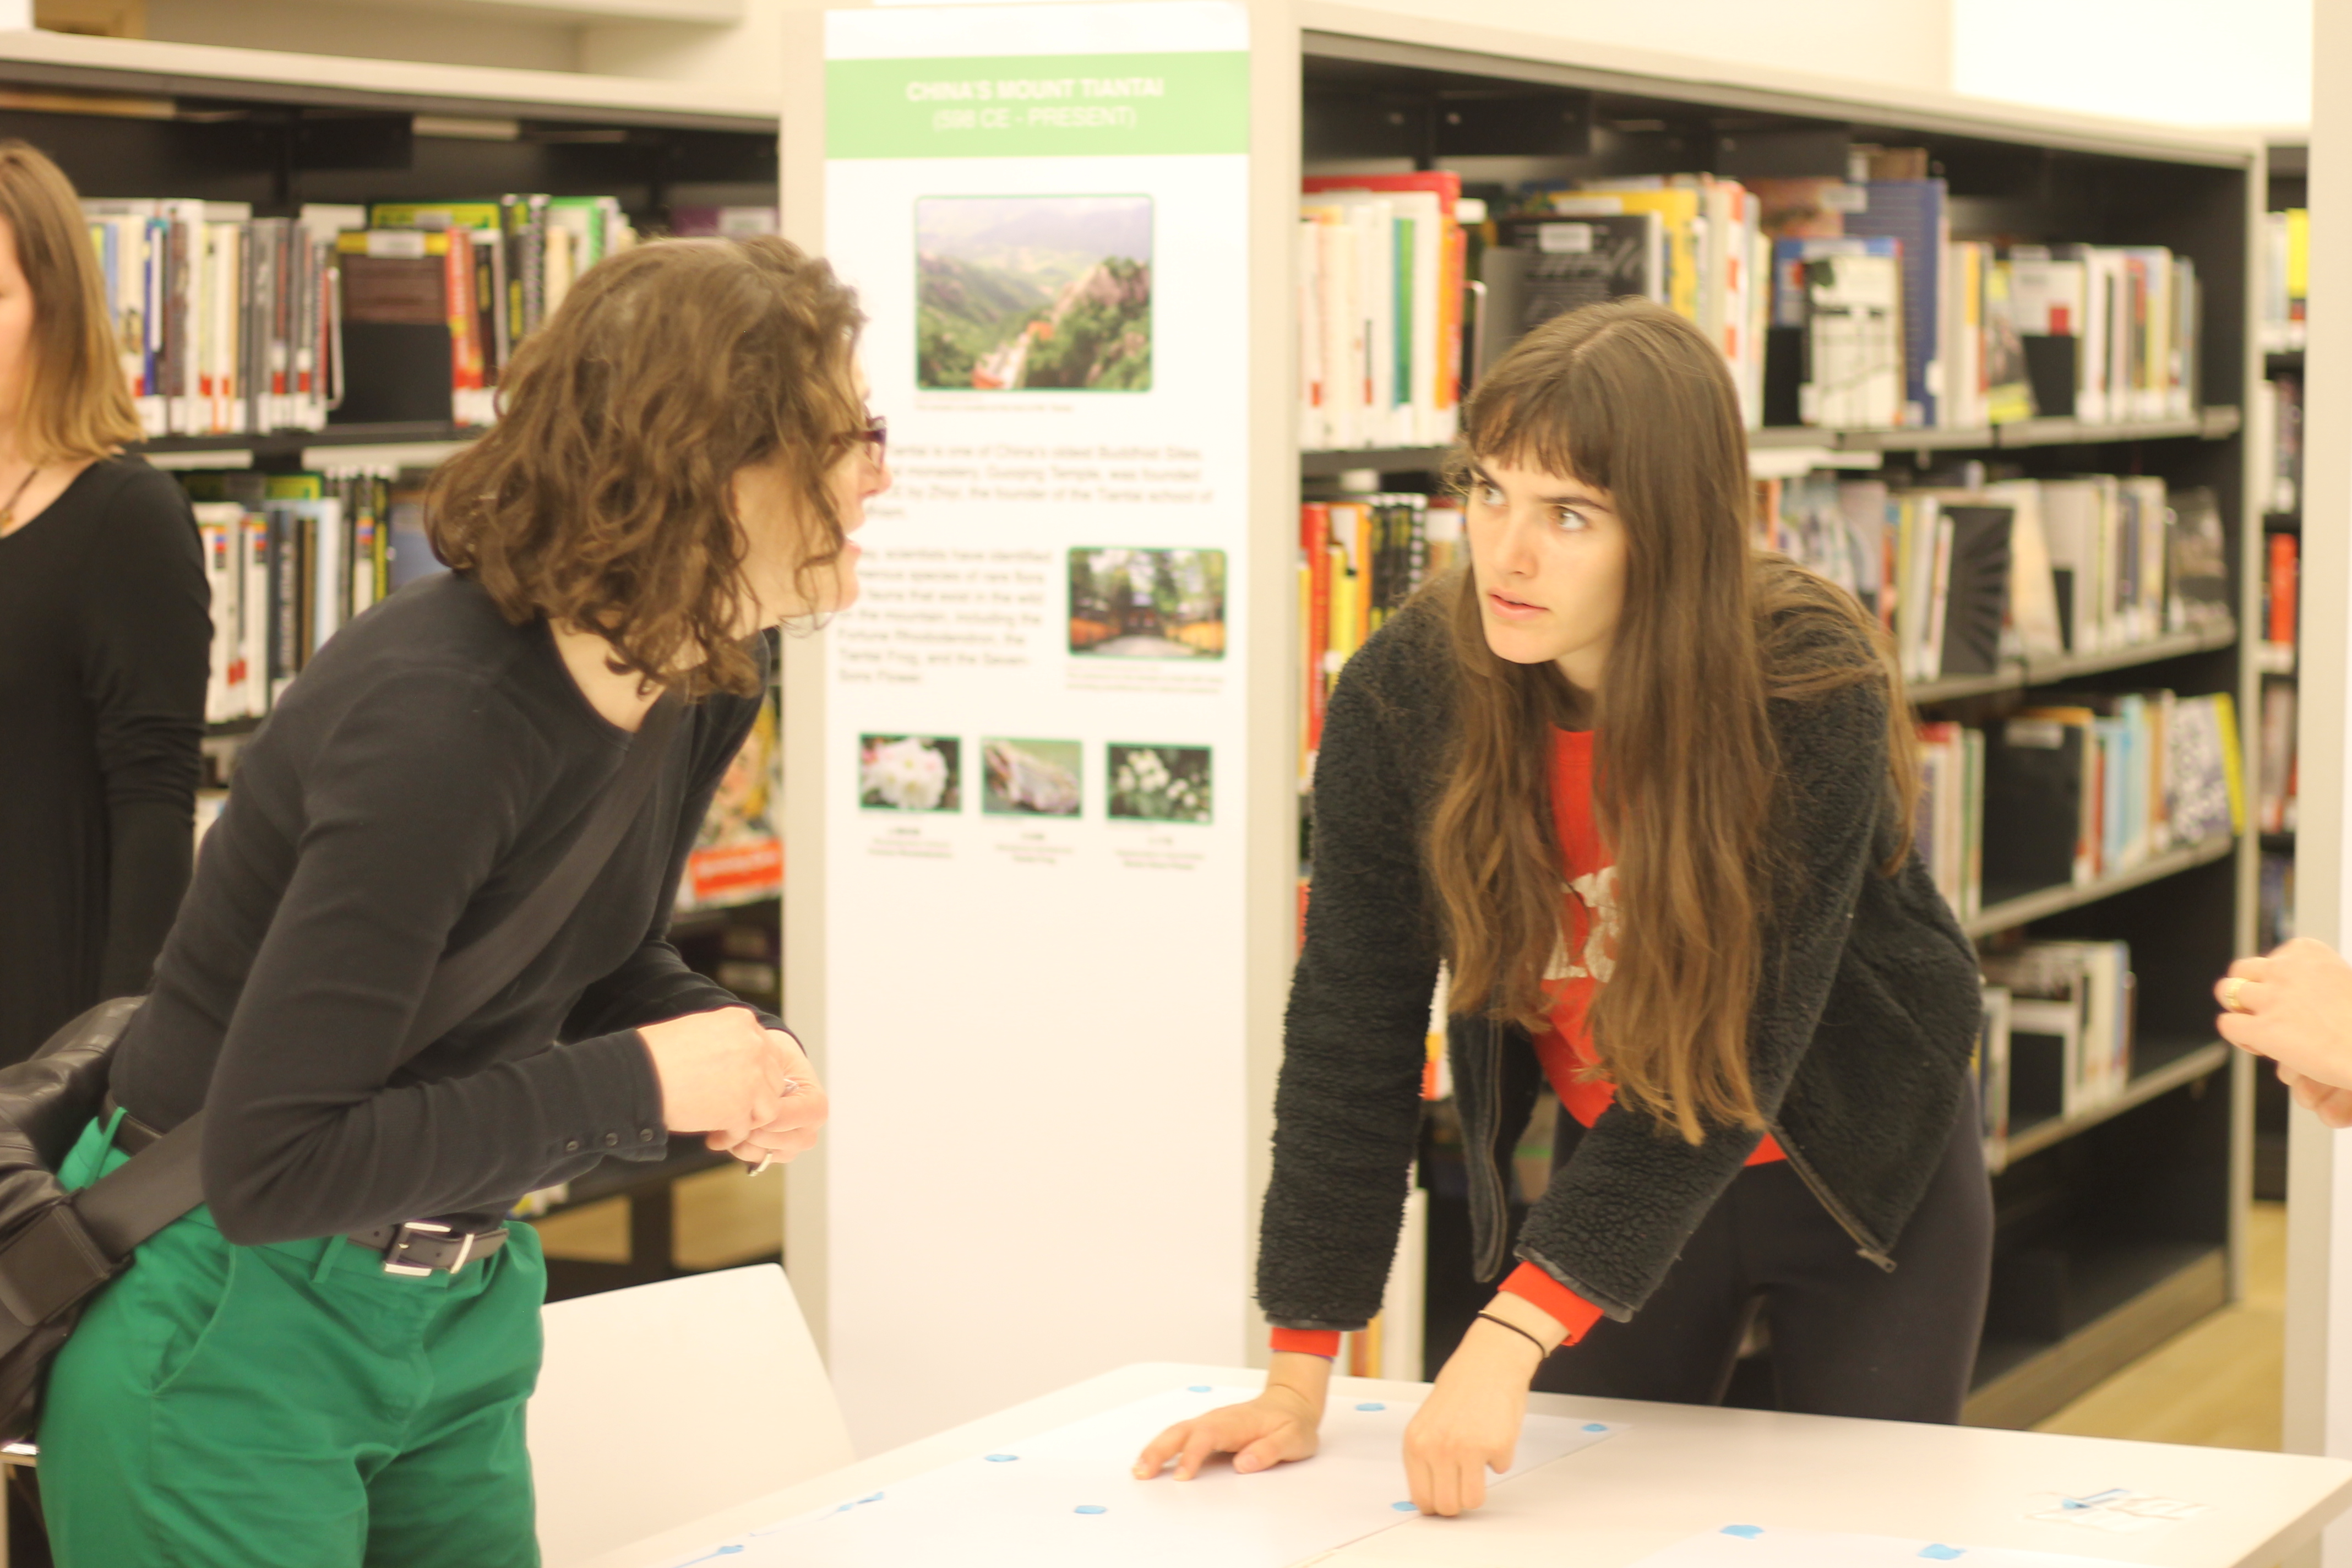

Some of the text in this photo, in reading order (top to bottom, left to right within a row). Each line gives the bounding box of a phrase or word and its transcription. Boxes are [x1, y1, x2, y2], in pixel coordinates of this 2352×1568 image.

[906, 77, 1164, 101] CHINA'S MOUNT TIANTAI
[980, 107, 1011, 128] CE
[1027, 106, 1137, 130] PRESENT)
